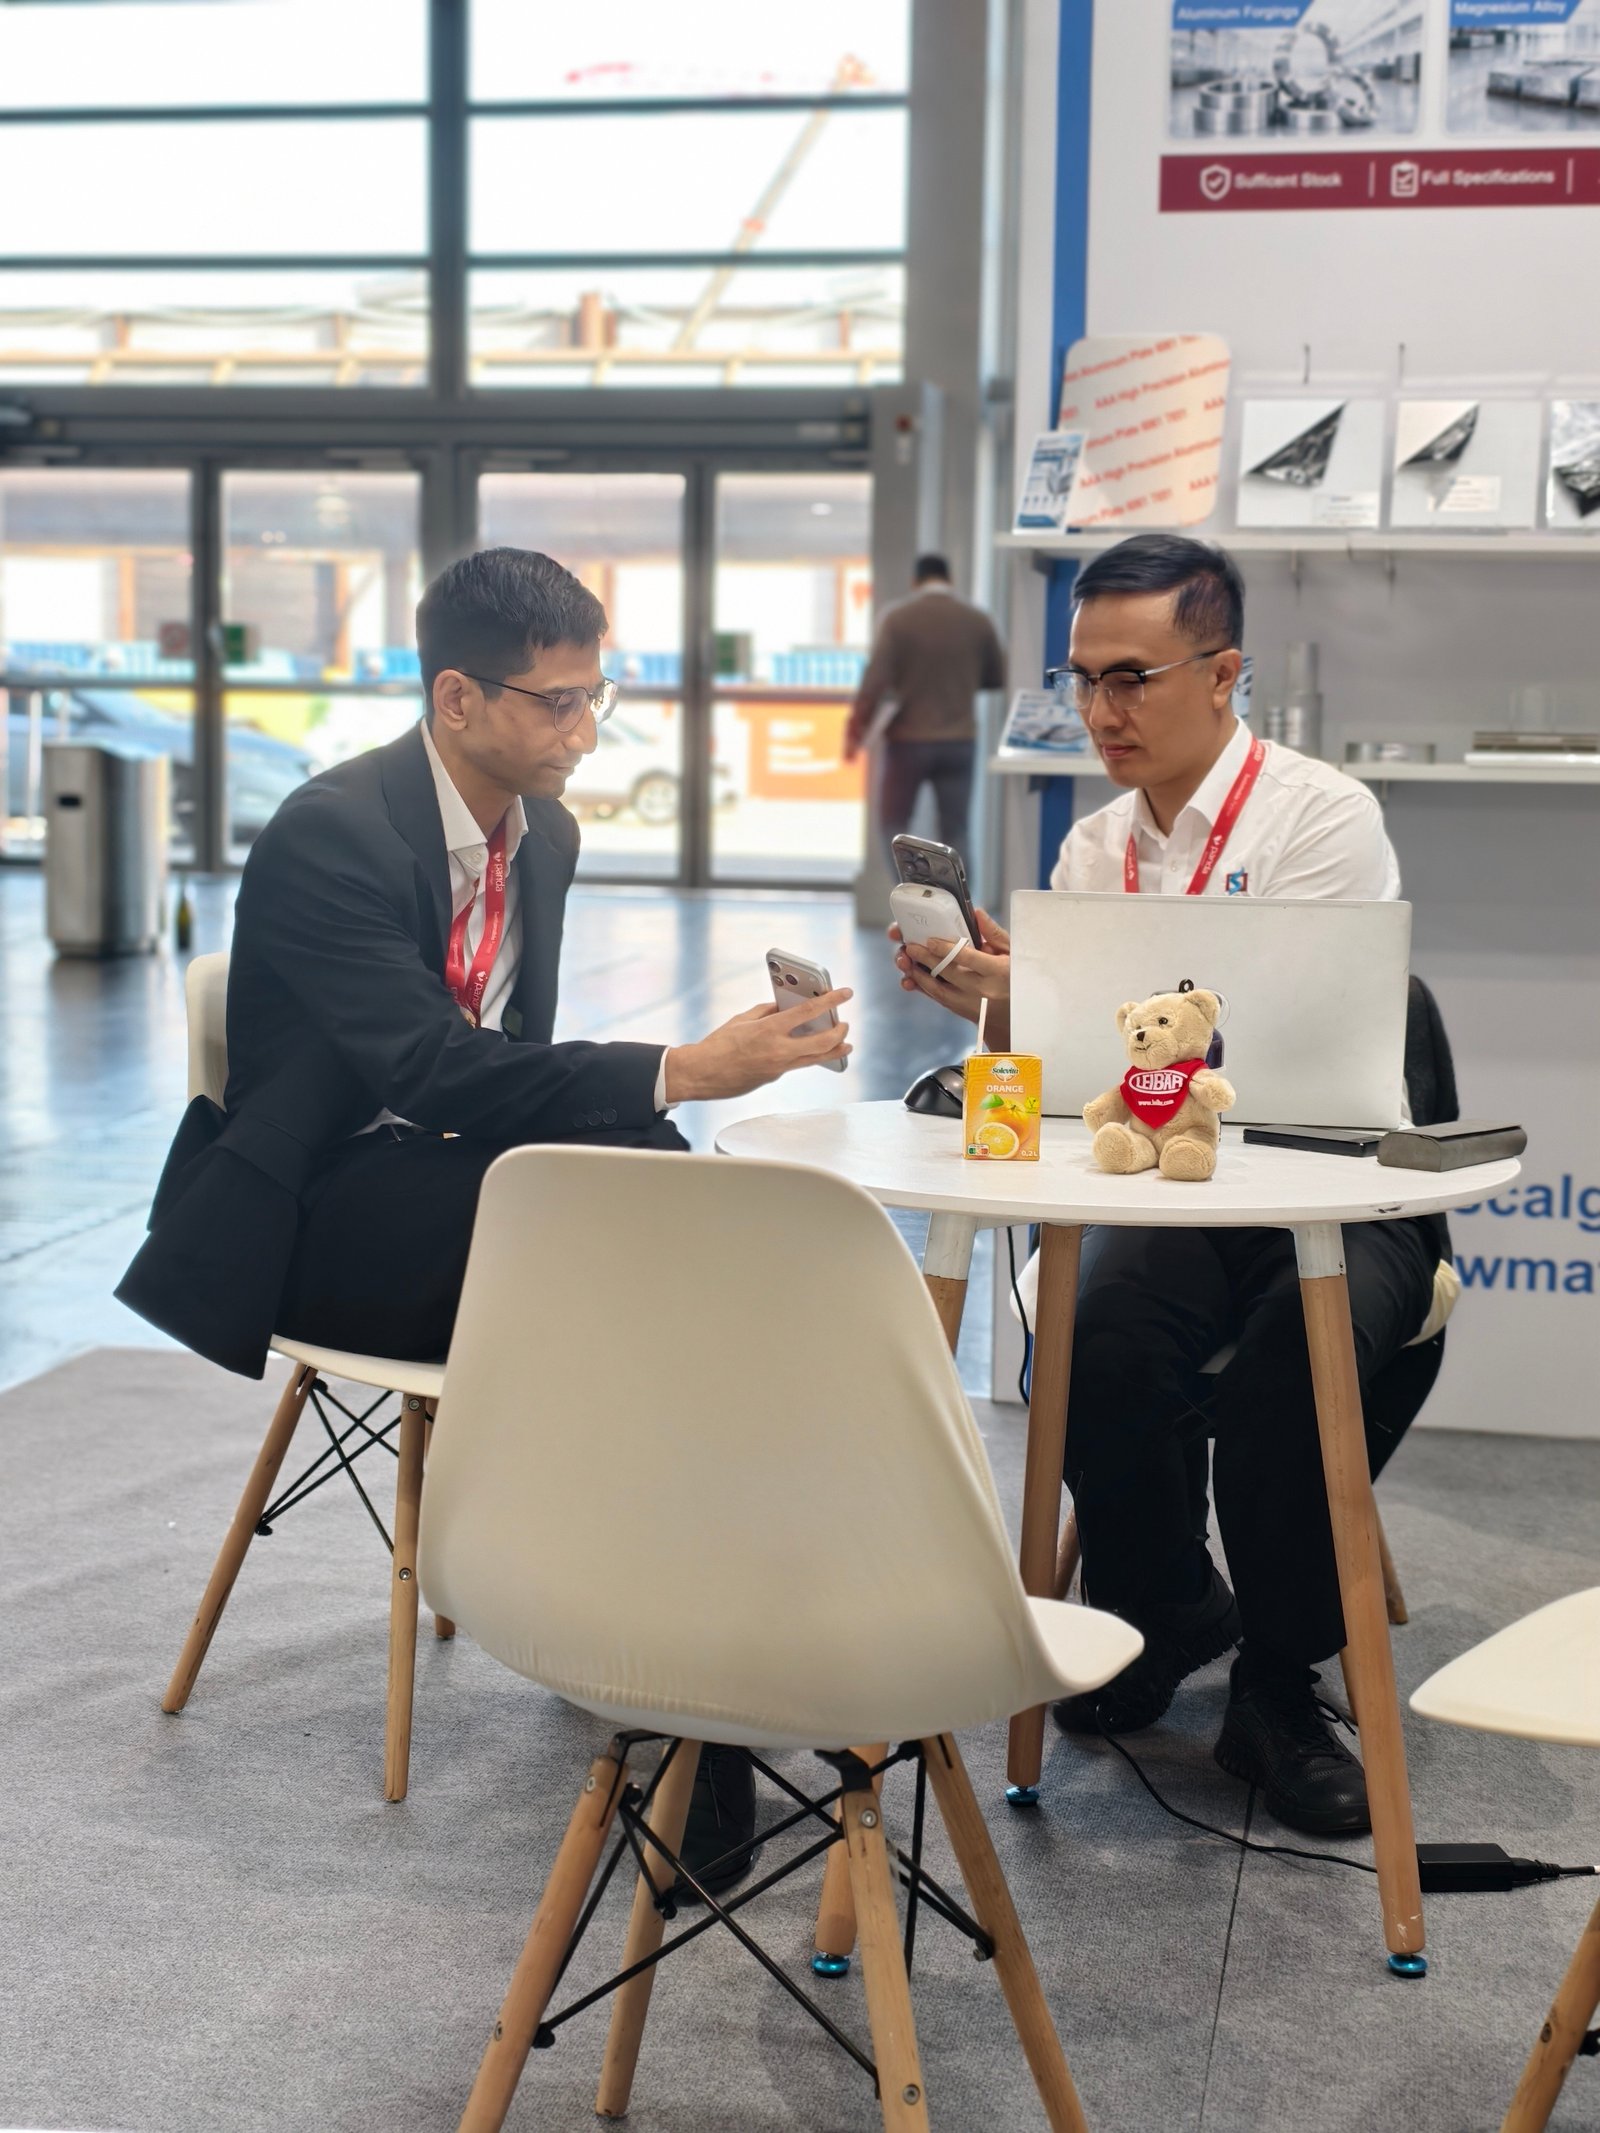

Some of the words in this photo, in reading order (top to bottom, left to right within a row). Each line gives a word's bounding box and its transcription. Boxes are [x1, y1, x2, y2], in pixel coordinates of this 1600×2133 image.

[1176, 7, 1240, 20] Aluminum
[1454, 2, 1531, 17] Magnesium
[1301, 172, 1342, 188] Stock
[1421, 169, 1450, 186] Full
[1452, 168, 1556, 188] Specifications
[1202, 845, 1219, 875] panda
[493, 863, 505, 892] panda
[986, 1084, 1024, 1093] ORANGE
[1135, 1072, 1184, 1091] LEIBÄR
[1453, 1255, 1600, 1294] wma
